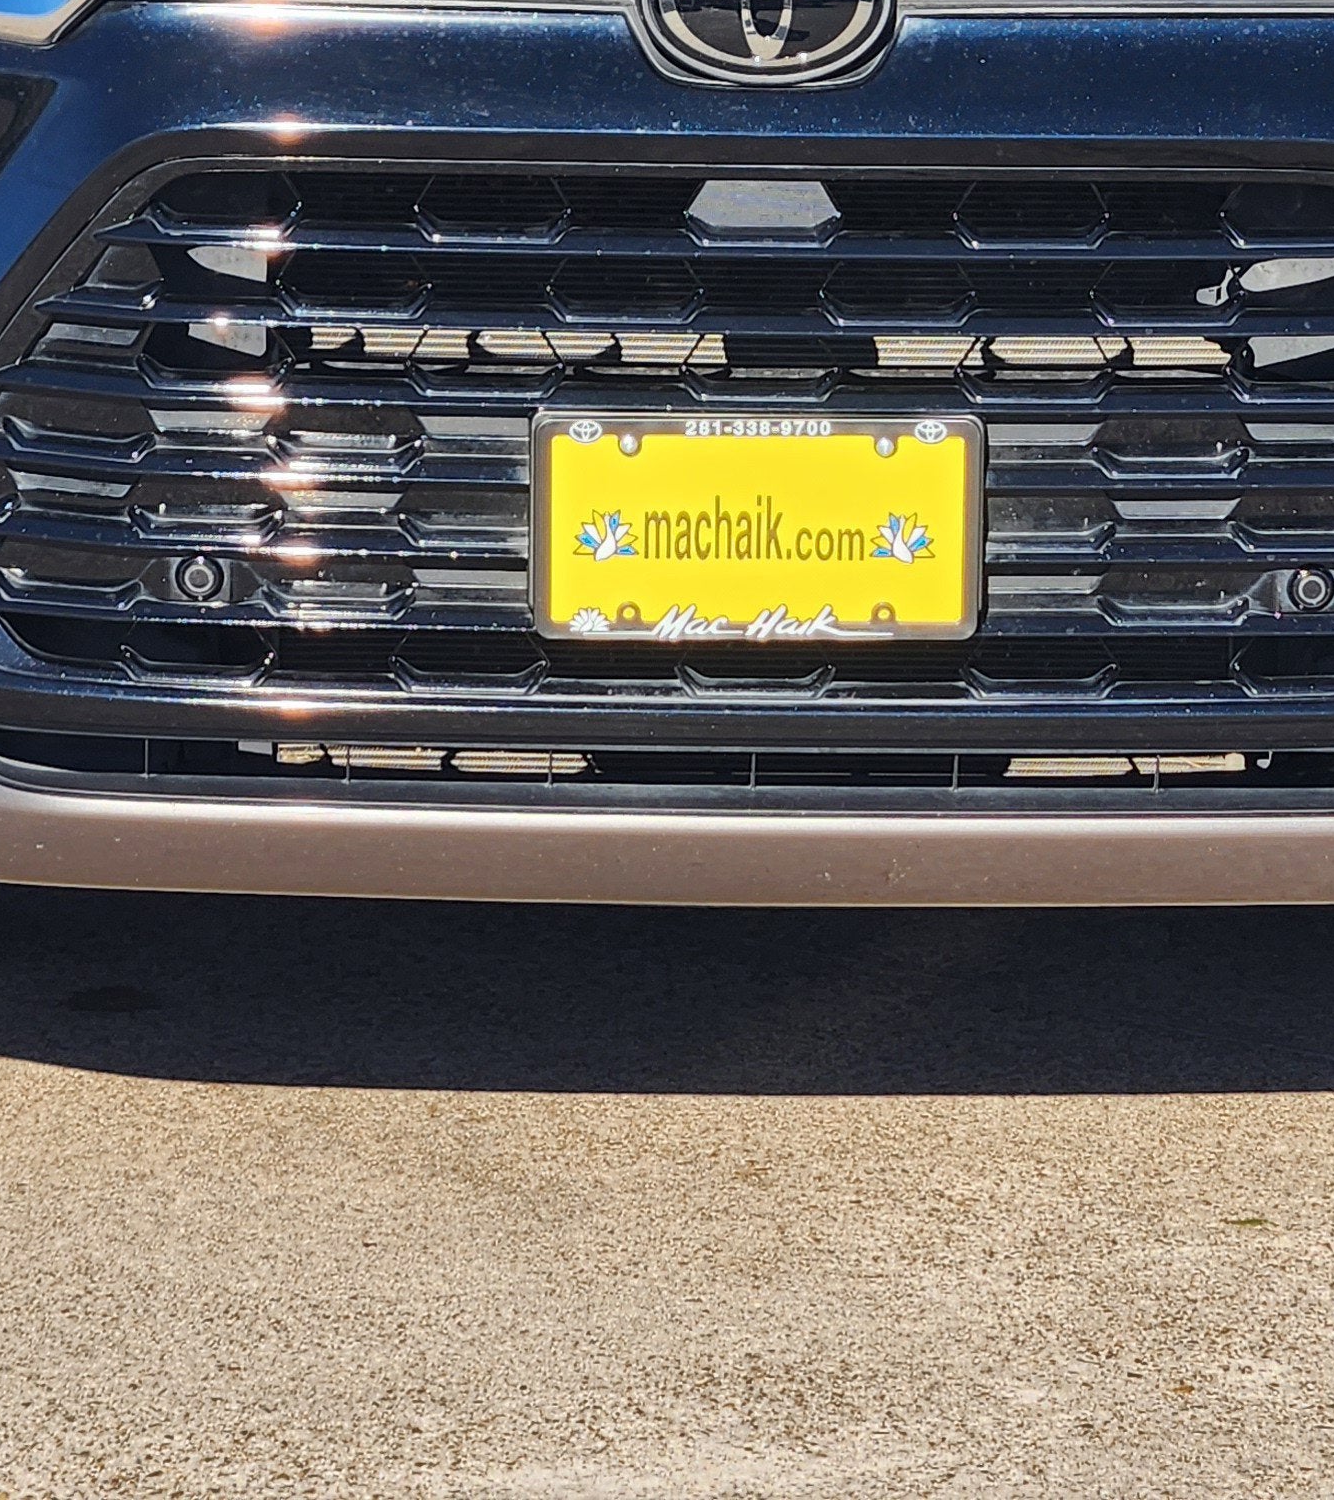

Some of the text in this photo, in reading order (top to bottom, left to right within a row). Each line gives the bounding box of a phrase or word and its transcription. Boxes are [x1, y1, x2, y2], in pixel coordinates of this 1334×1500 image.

[684, 420, 833, 437] 281-338-9700
[643, 495, 866, 562] machaik.com
[639, 603, 857, 640] Mac Haik
